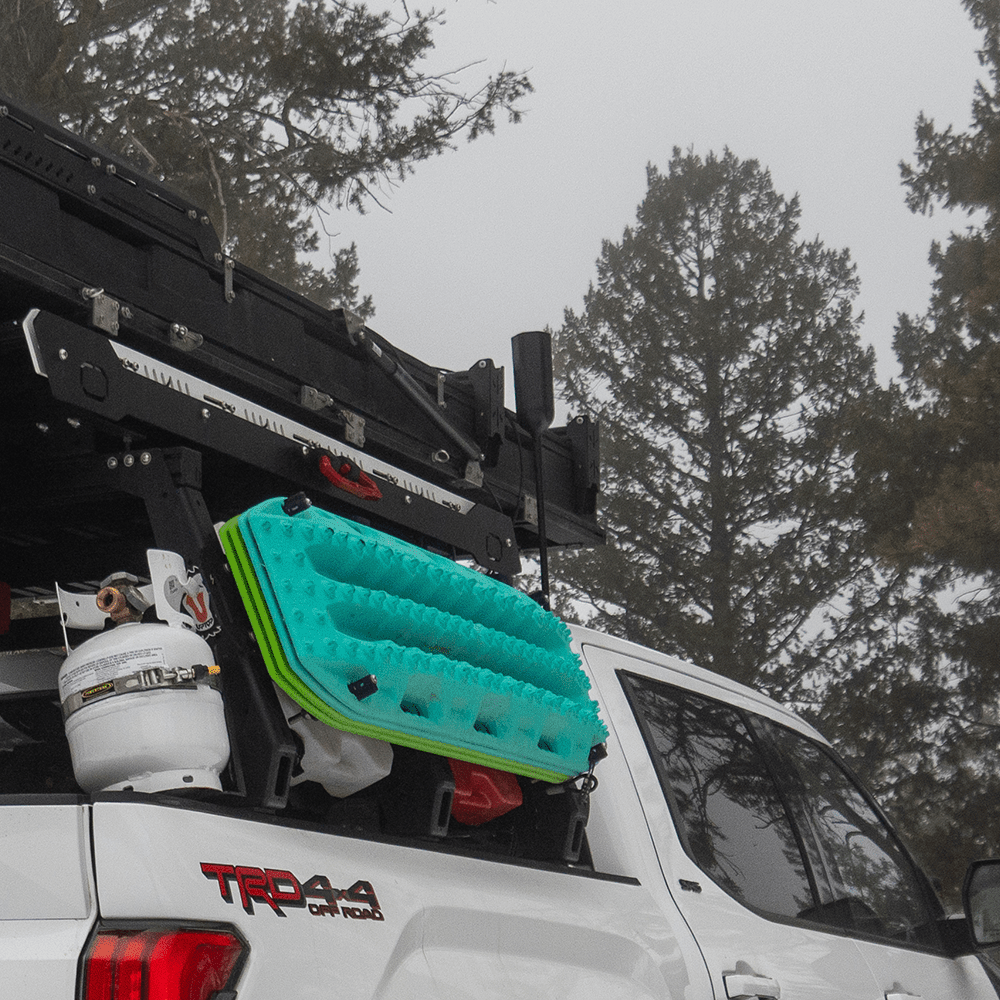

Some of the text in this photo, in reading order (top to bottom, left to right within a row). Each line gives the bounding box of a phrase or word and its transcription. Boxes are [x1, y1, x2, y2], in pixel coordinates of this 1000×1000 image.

[200, 862, 307, 918] TRD
[308, 903, 386, 922] OFF ROAD
